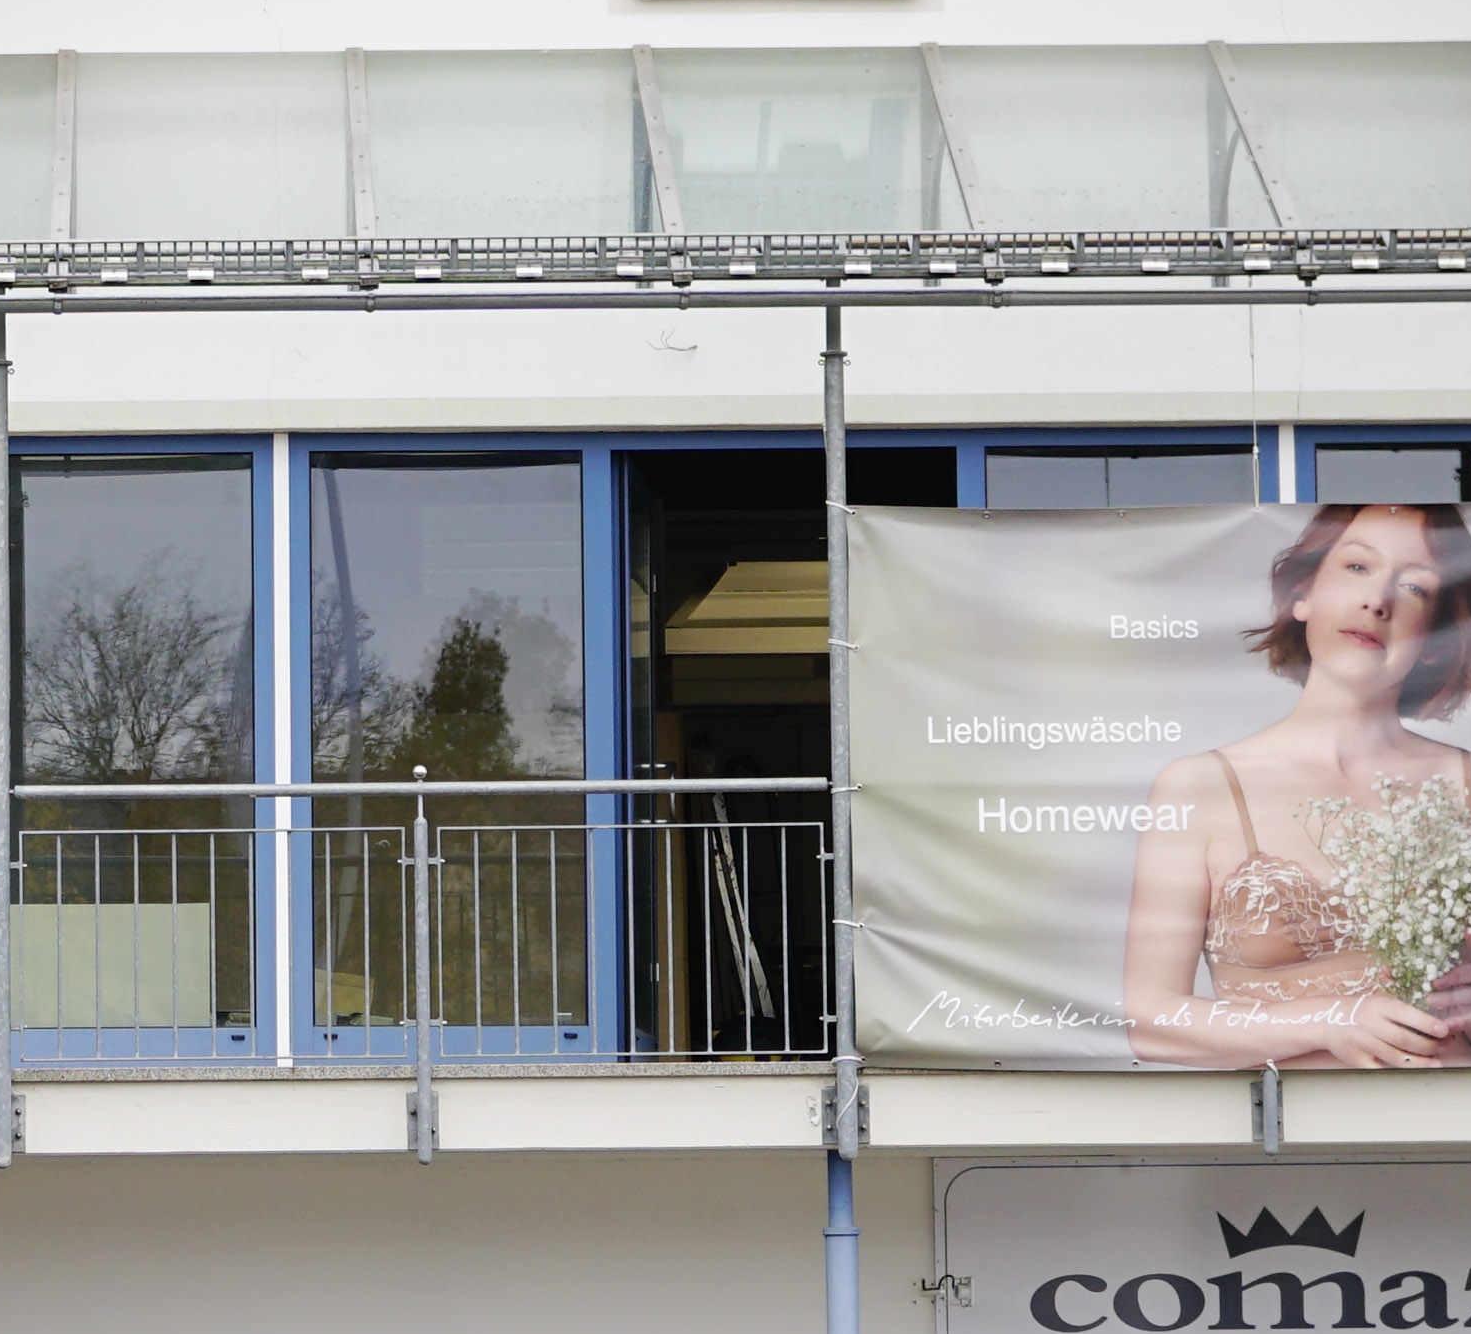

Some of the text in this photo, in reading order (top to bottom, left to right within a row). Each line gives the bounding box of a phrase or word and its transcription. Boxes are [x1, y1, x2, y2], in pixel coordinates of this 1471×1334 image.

[1110, 614, 1199, 640] Basics
[926, 715, 1182, 750] Lieblingswäsche
[977, 797, 1196, 834] Homewear
[906, 990, 1138, 1033] Mitarbeiterin
[1153, 1002, 1193, 1029] als
